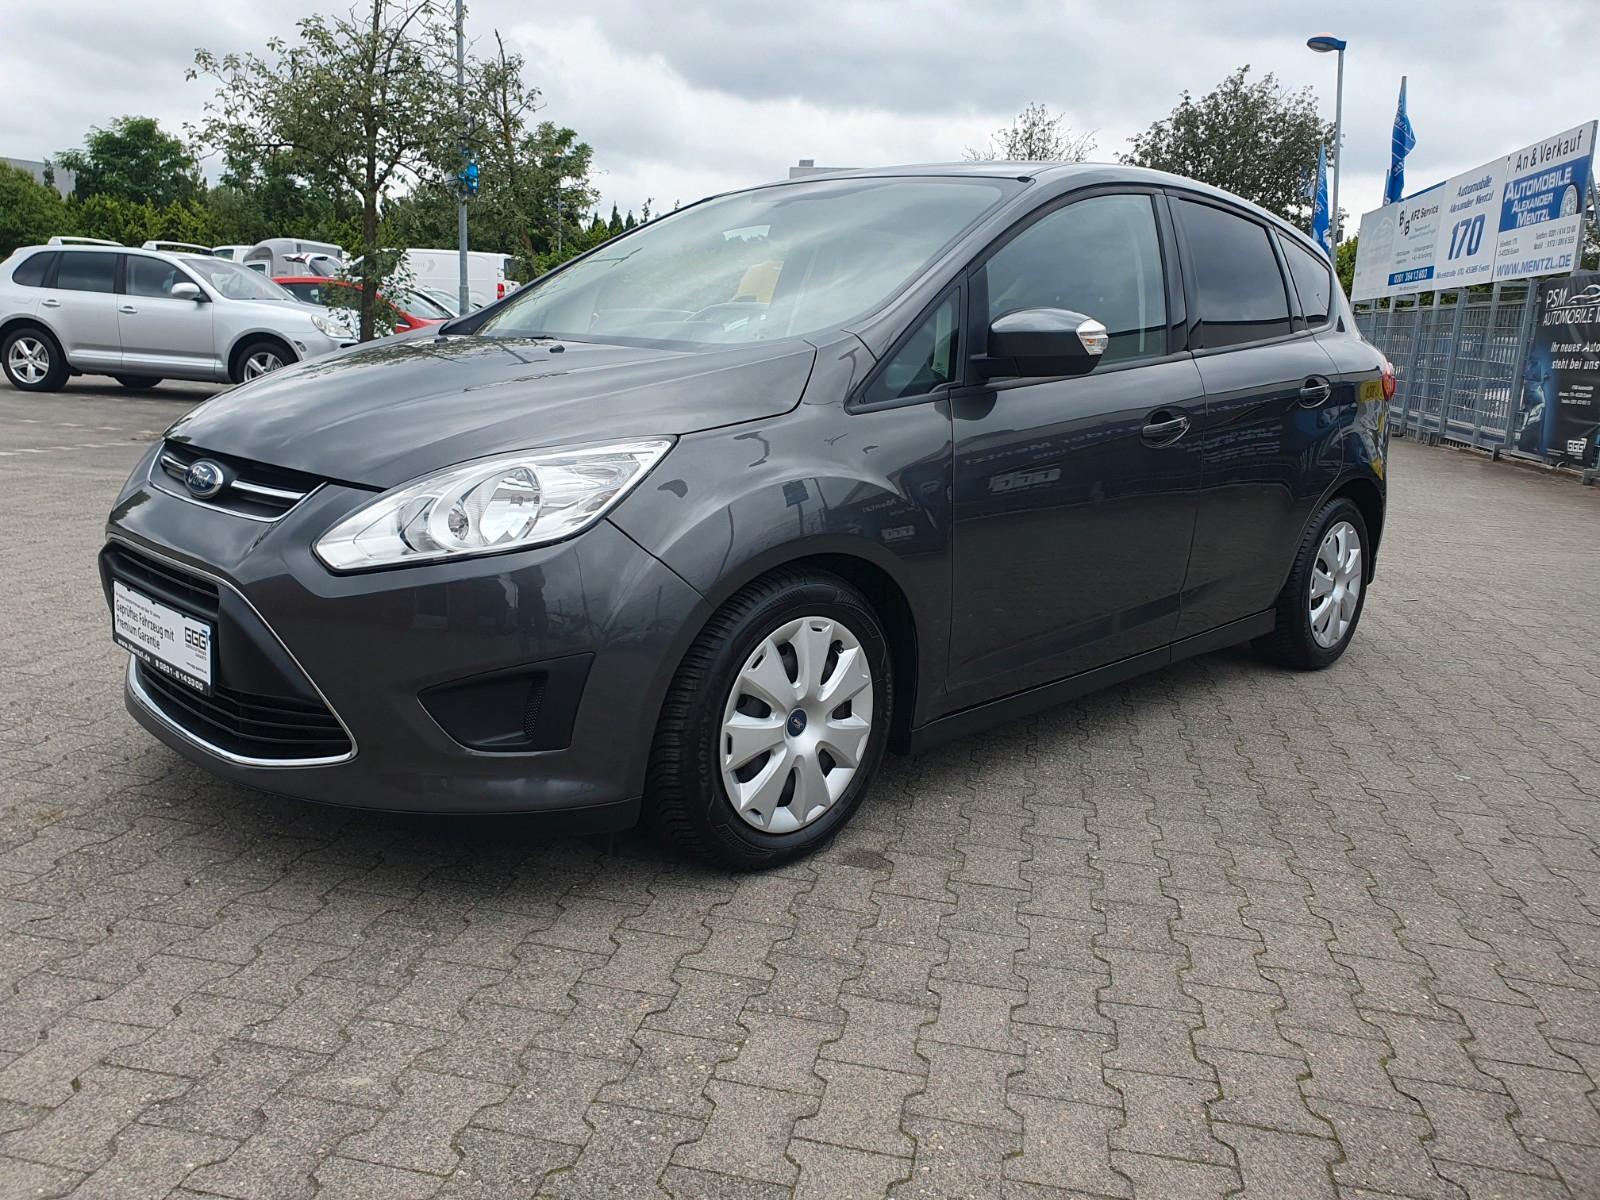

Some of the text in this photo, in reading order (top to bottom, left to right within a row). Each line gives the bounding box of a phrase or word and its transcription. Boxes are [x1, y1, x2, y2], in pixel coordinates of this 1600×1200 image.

[1515, 129, 1583, 172] An & Verkauf
[1504, 166, 1573, 203] AUTOMOBILE
[1420, 204, 1439, 219] Service
[1516, 209, 1550, 228] MENTZL
[1448, 213, 1486, 260] 170
[1546, 287, 1568, 308] PSM
[1543, 307, 1595, 327] AUTOMOBILE
[1569, 357, 1583, 370] bei
[1584, 360, 1600, 370] uns
[164, 628, 175, 642] mit
